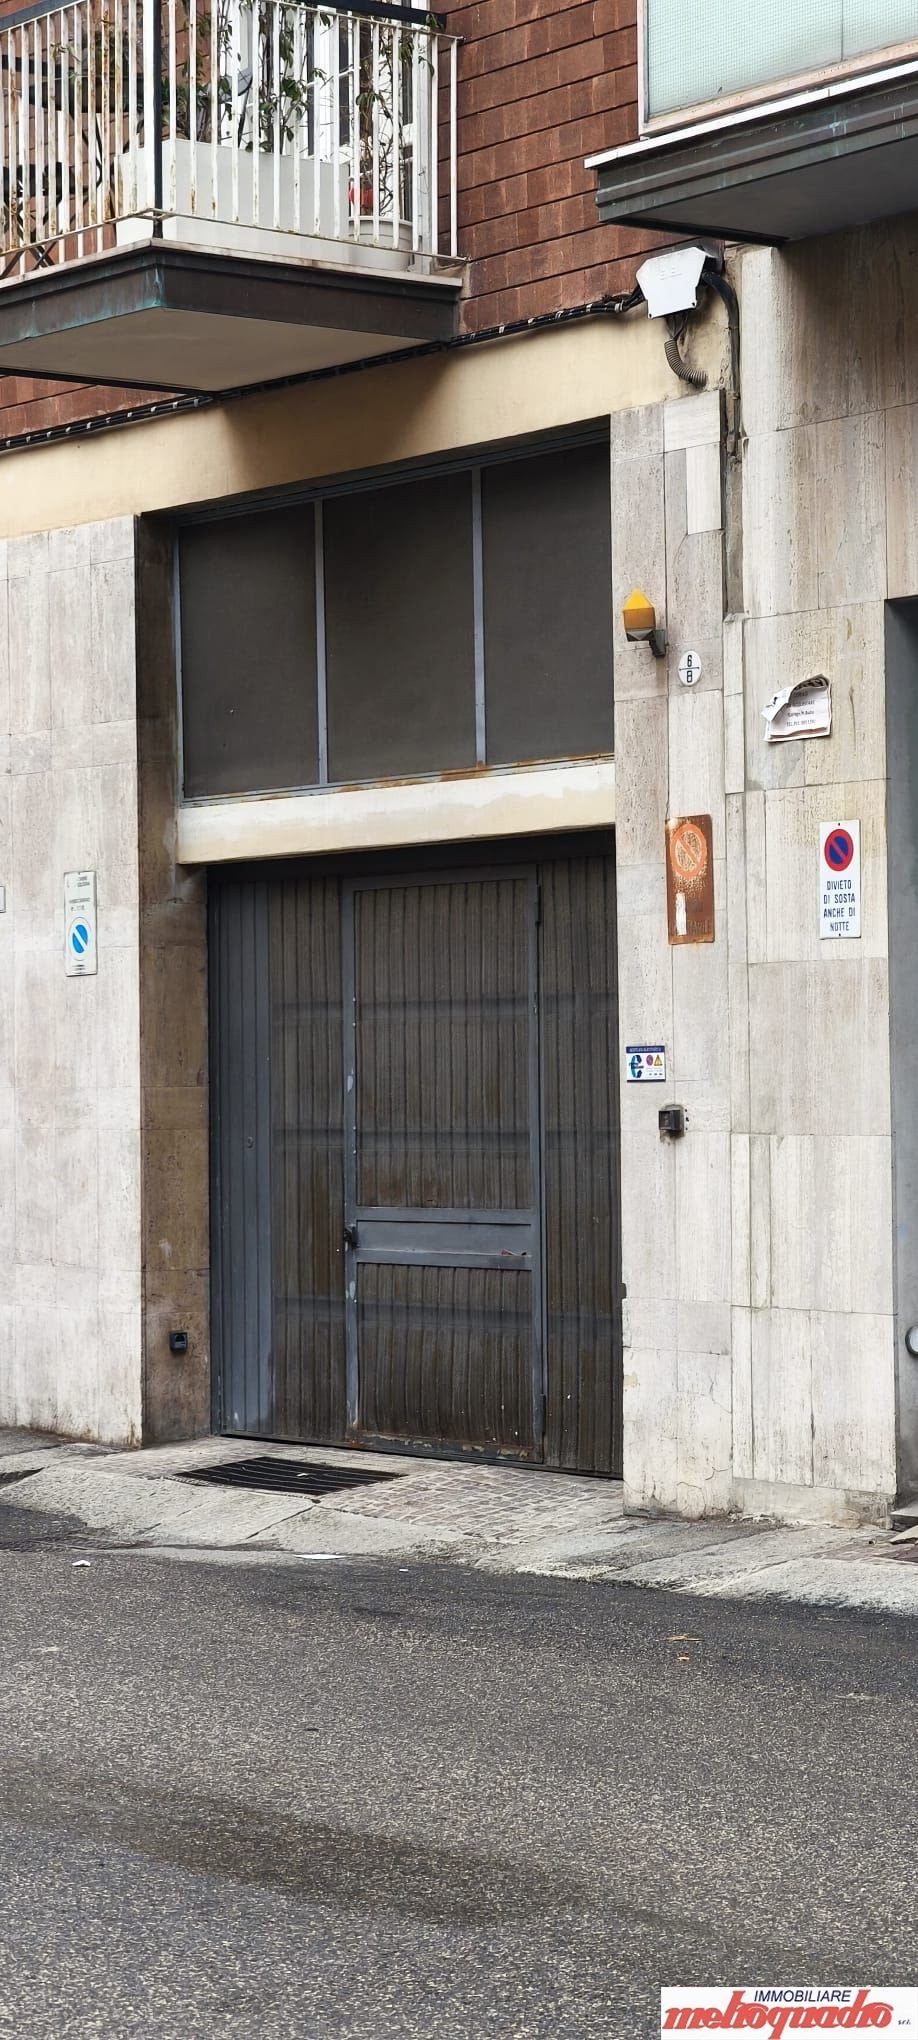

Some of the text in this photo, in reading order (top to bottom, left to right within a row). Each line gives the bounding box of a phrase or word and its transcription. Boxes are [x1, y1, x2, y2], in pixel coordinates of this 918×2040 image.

[686, 654, 693, 667] 6
[826, 880, 852, 891] DIVIETO
[823, 893, 856, 905] DI SOSTA
[823, 907, 856, 918] ANCHE DI
[830, 921, 850, 932] NOTTE
